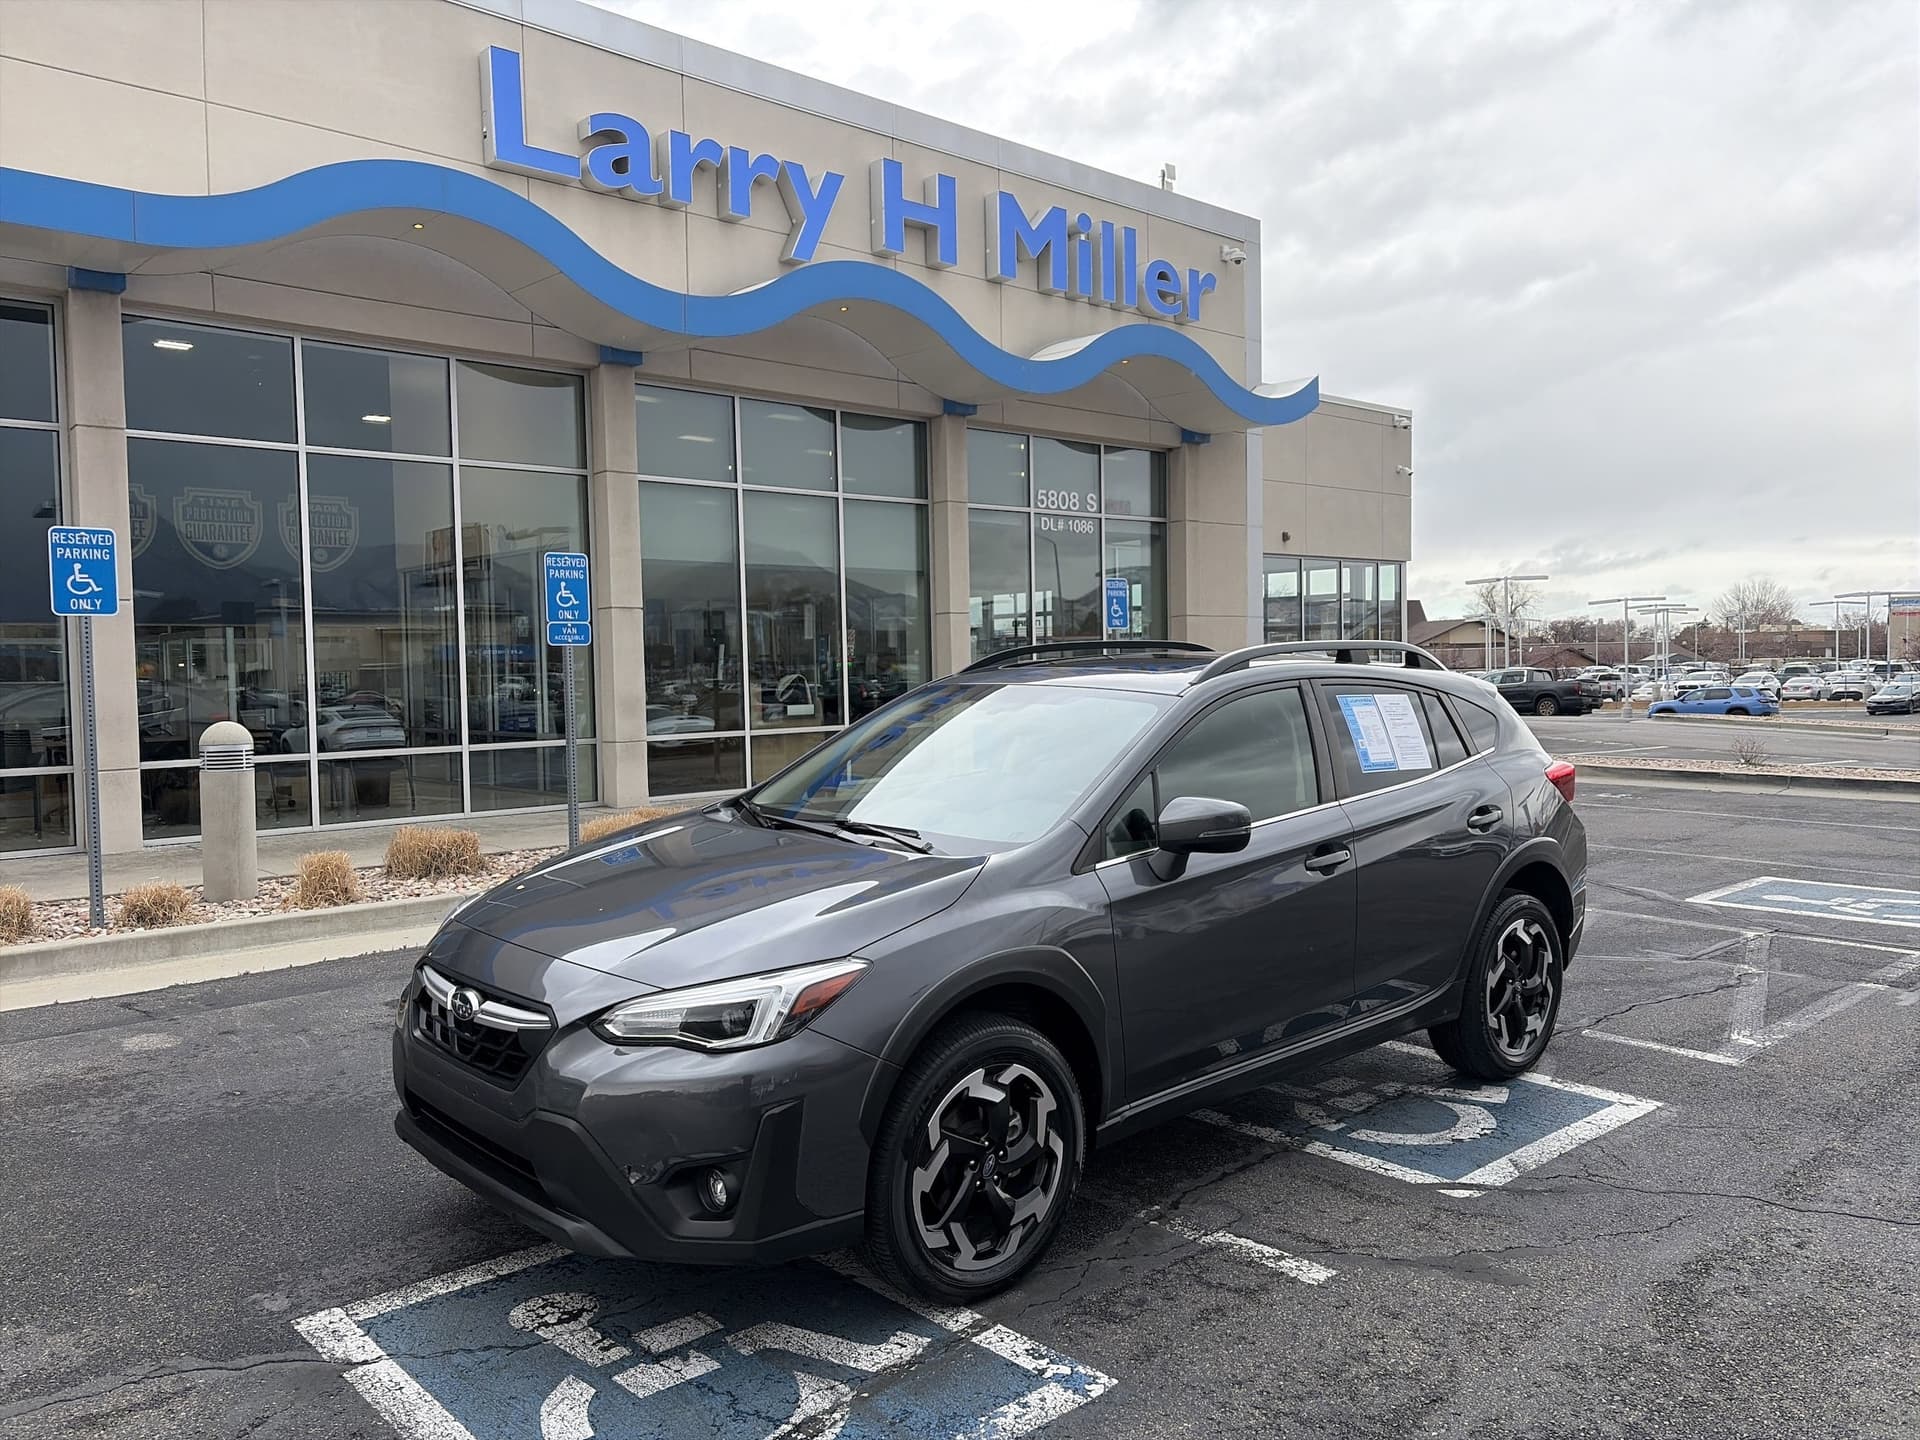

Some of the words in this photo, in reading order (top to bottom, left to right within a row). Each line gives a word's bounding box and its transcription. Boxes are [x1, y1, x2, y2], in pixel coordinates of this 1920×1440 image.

[481, 45, 845, 263] Larry
[870, 157, 958, 268] H
[986, 190, 1217, 323] Miller
[1037, 489, 1080, 511] 5808
[1086, 492, 1097, 512] S
[184, 506, 250, 522] PROTECTION
[1040, 516, 1064, 531] DL#
[1068, 519, 1094, 534] 1086
[184, 522, 252, 542] GUARANTEE
[51, 532, 113, 546] RESERVED
[56, 547, 110, 560] PARKING
[546, 557, 586, 568] RESERVED
[549, 569, 585, 580] PARKING
[70, 598, 102, 610] ONLY
[558, 610, 580, 620] ONLY
[562, 627, 577, 635] VAN
[554, 634, 585, 642] ACCESSIBLE
